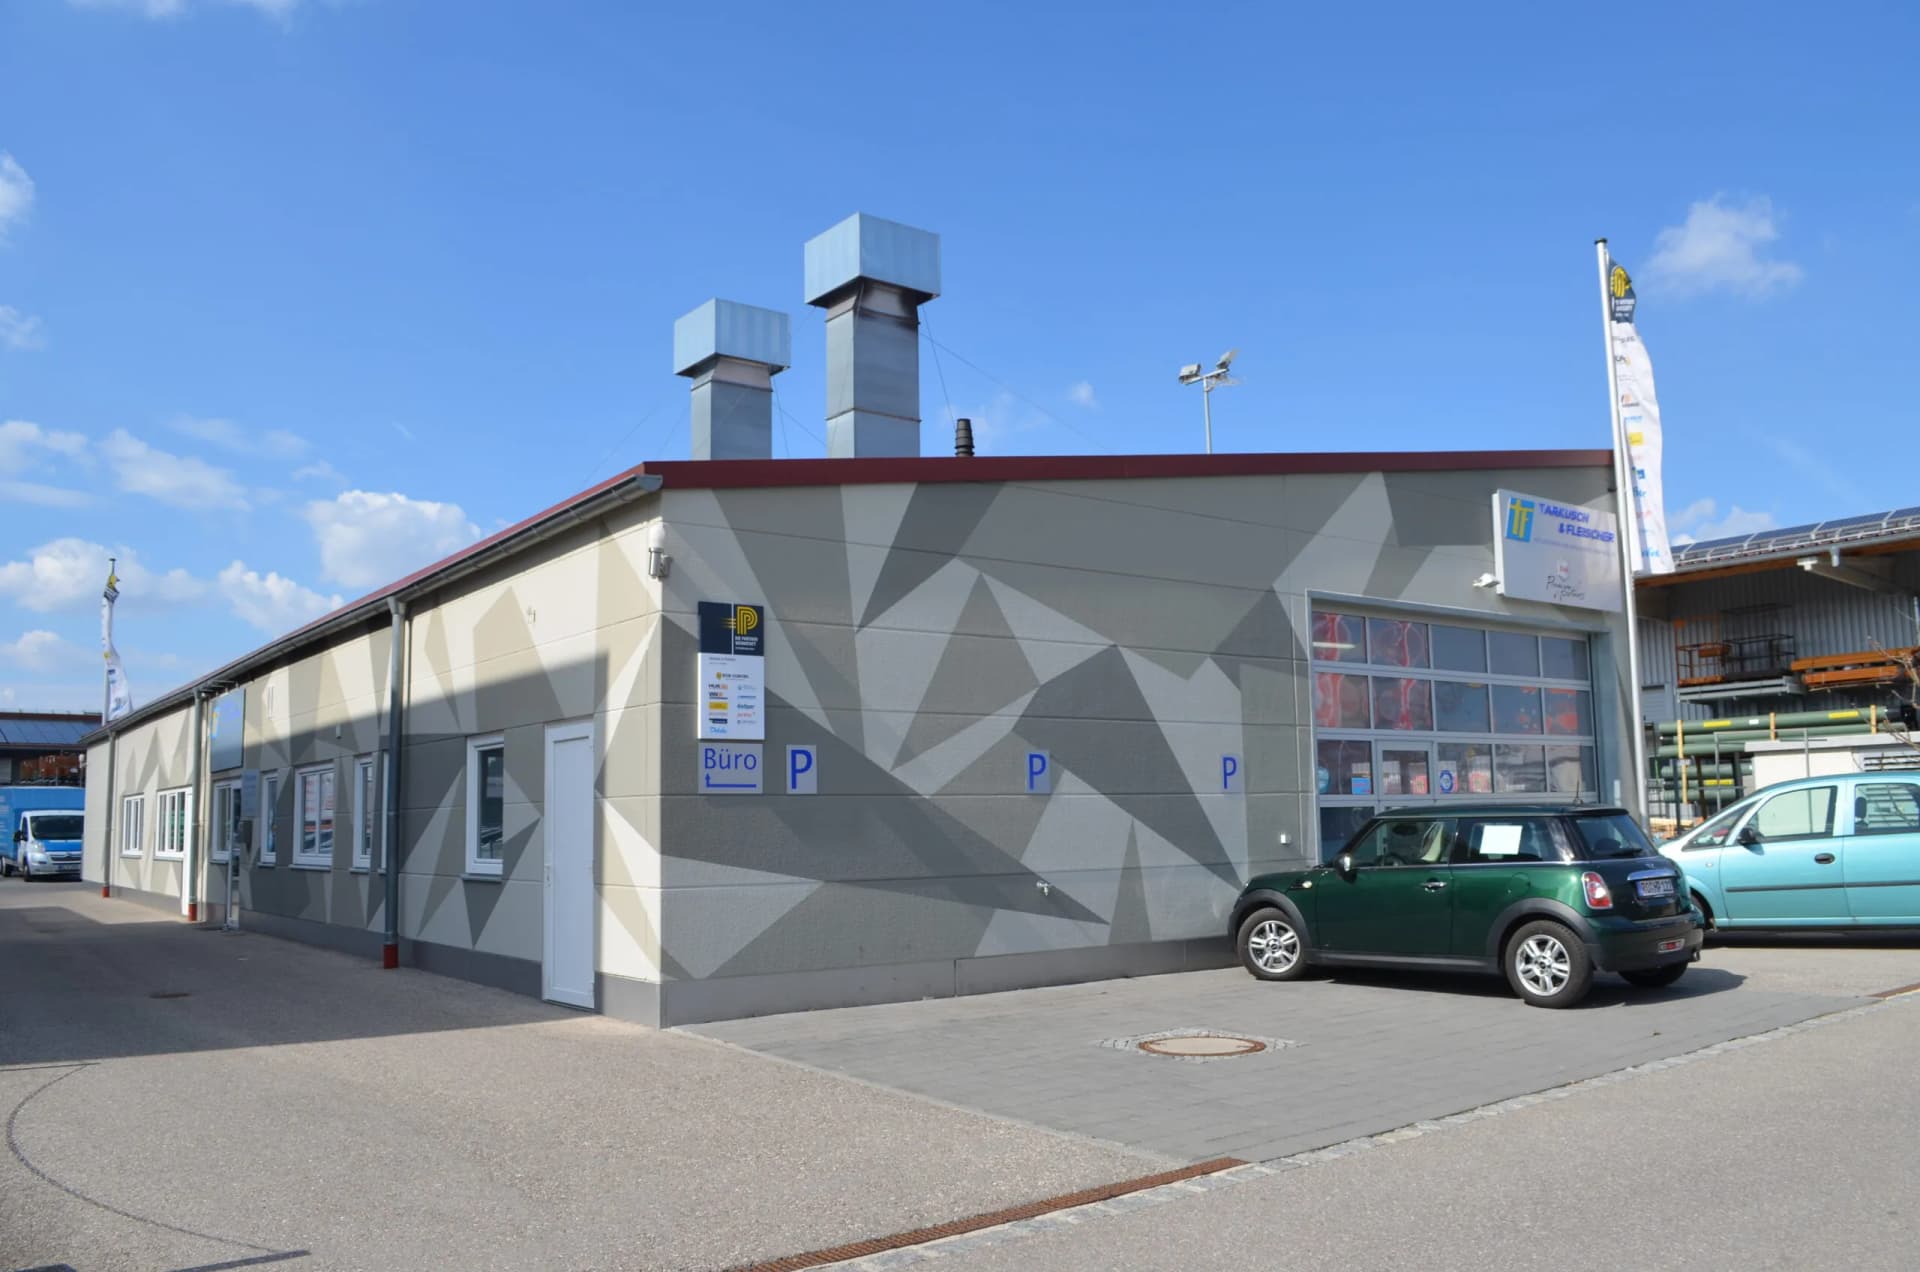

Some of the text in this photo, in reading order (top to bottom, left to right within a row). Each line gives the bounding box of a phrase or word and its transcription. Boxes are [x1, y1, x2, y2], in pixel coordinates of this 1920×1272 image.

[1538, 502, 1590, 524] TARKUSCH
[1566, 524, 1615, 543] FLEISCHER
[704, 747, 757, 770] Büro
[791, 749, 813, 790] P
[1029, 753, 1046, 790] P
[1223, 756, 1237, 790] P
